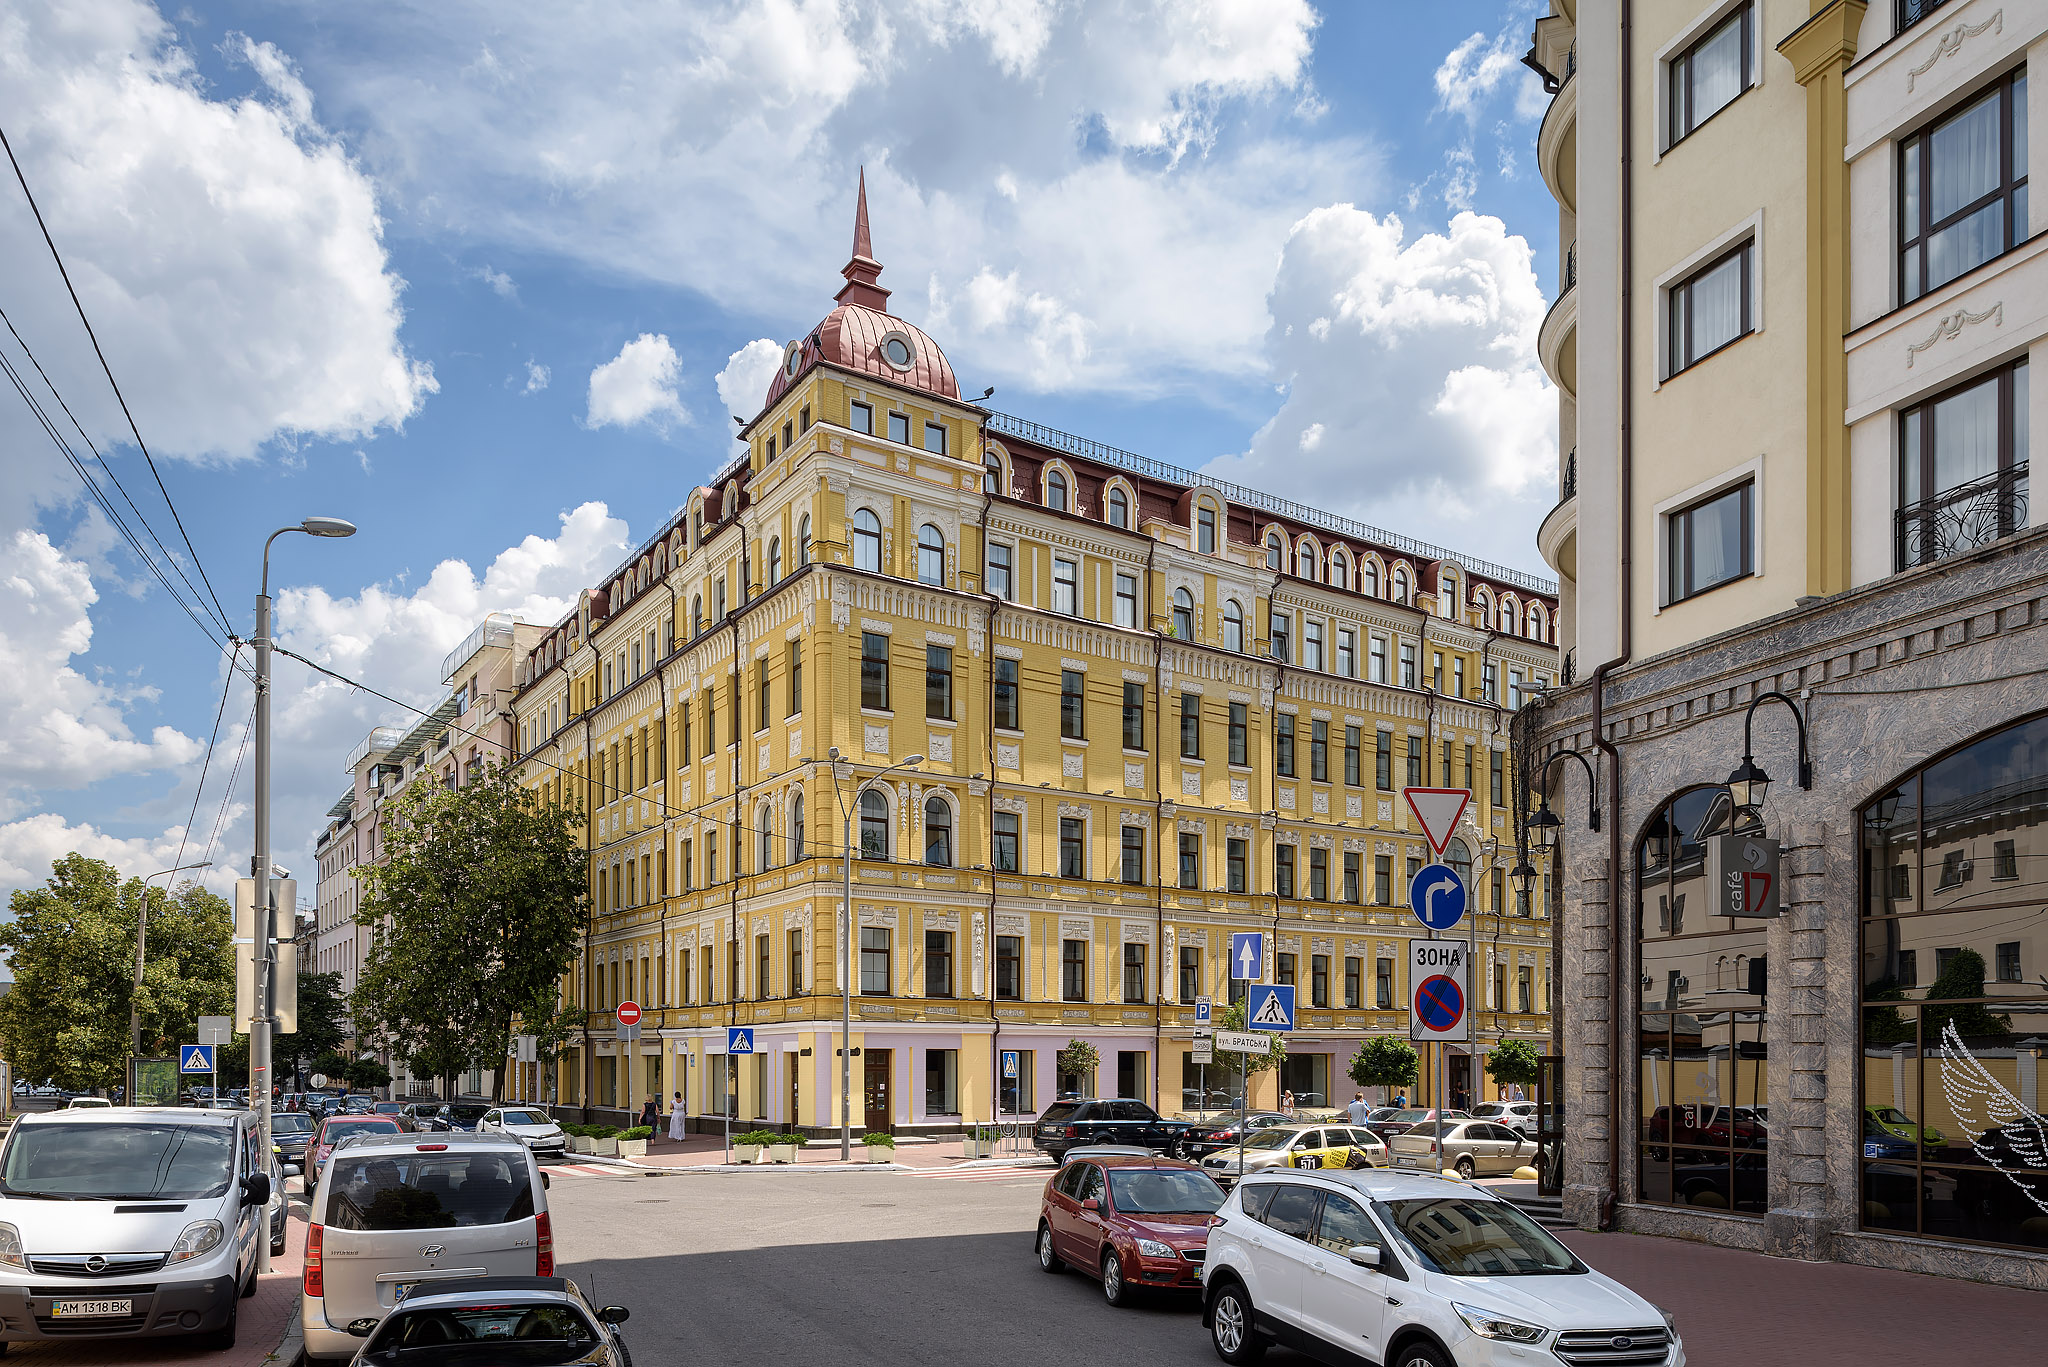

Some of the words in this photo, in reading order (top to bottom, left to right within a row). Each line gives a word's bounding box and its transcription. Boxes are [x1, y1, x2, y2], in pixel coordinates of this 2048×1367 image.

[1727, 871, 1742, 911] café
[1742, 871, 1772, 912] 17
[1416, 947, 1461, 966] ЗОНА
[1199, 1004, 1208, 1019] P
[1218, 1038, 1231, 1046] вул.
[1232, 1037, 1268, 1049] БРАТСЬКА
[1300, 1158, 1316, 1170] 571
[61, 1303, 79, 1314] AM
[82, 1302, 109, 1313] 1318
[111, 1301, 129, 1312] BK
